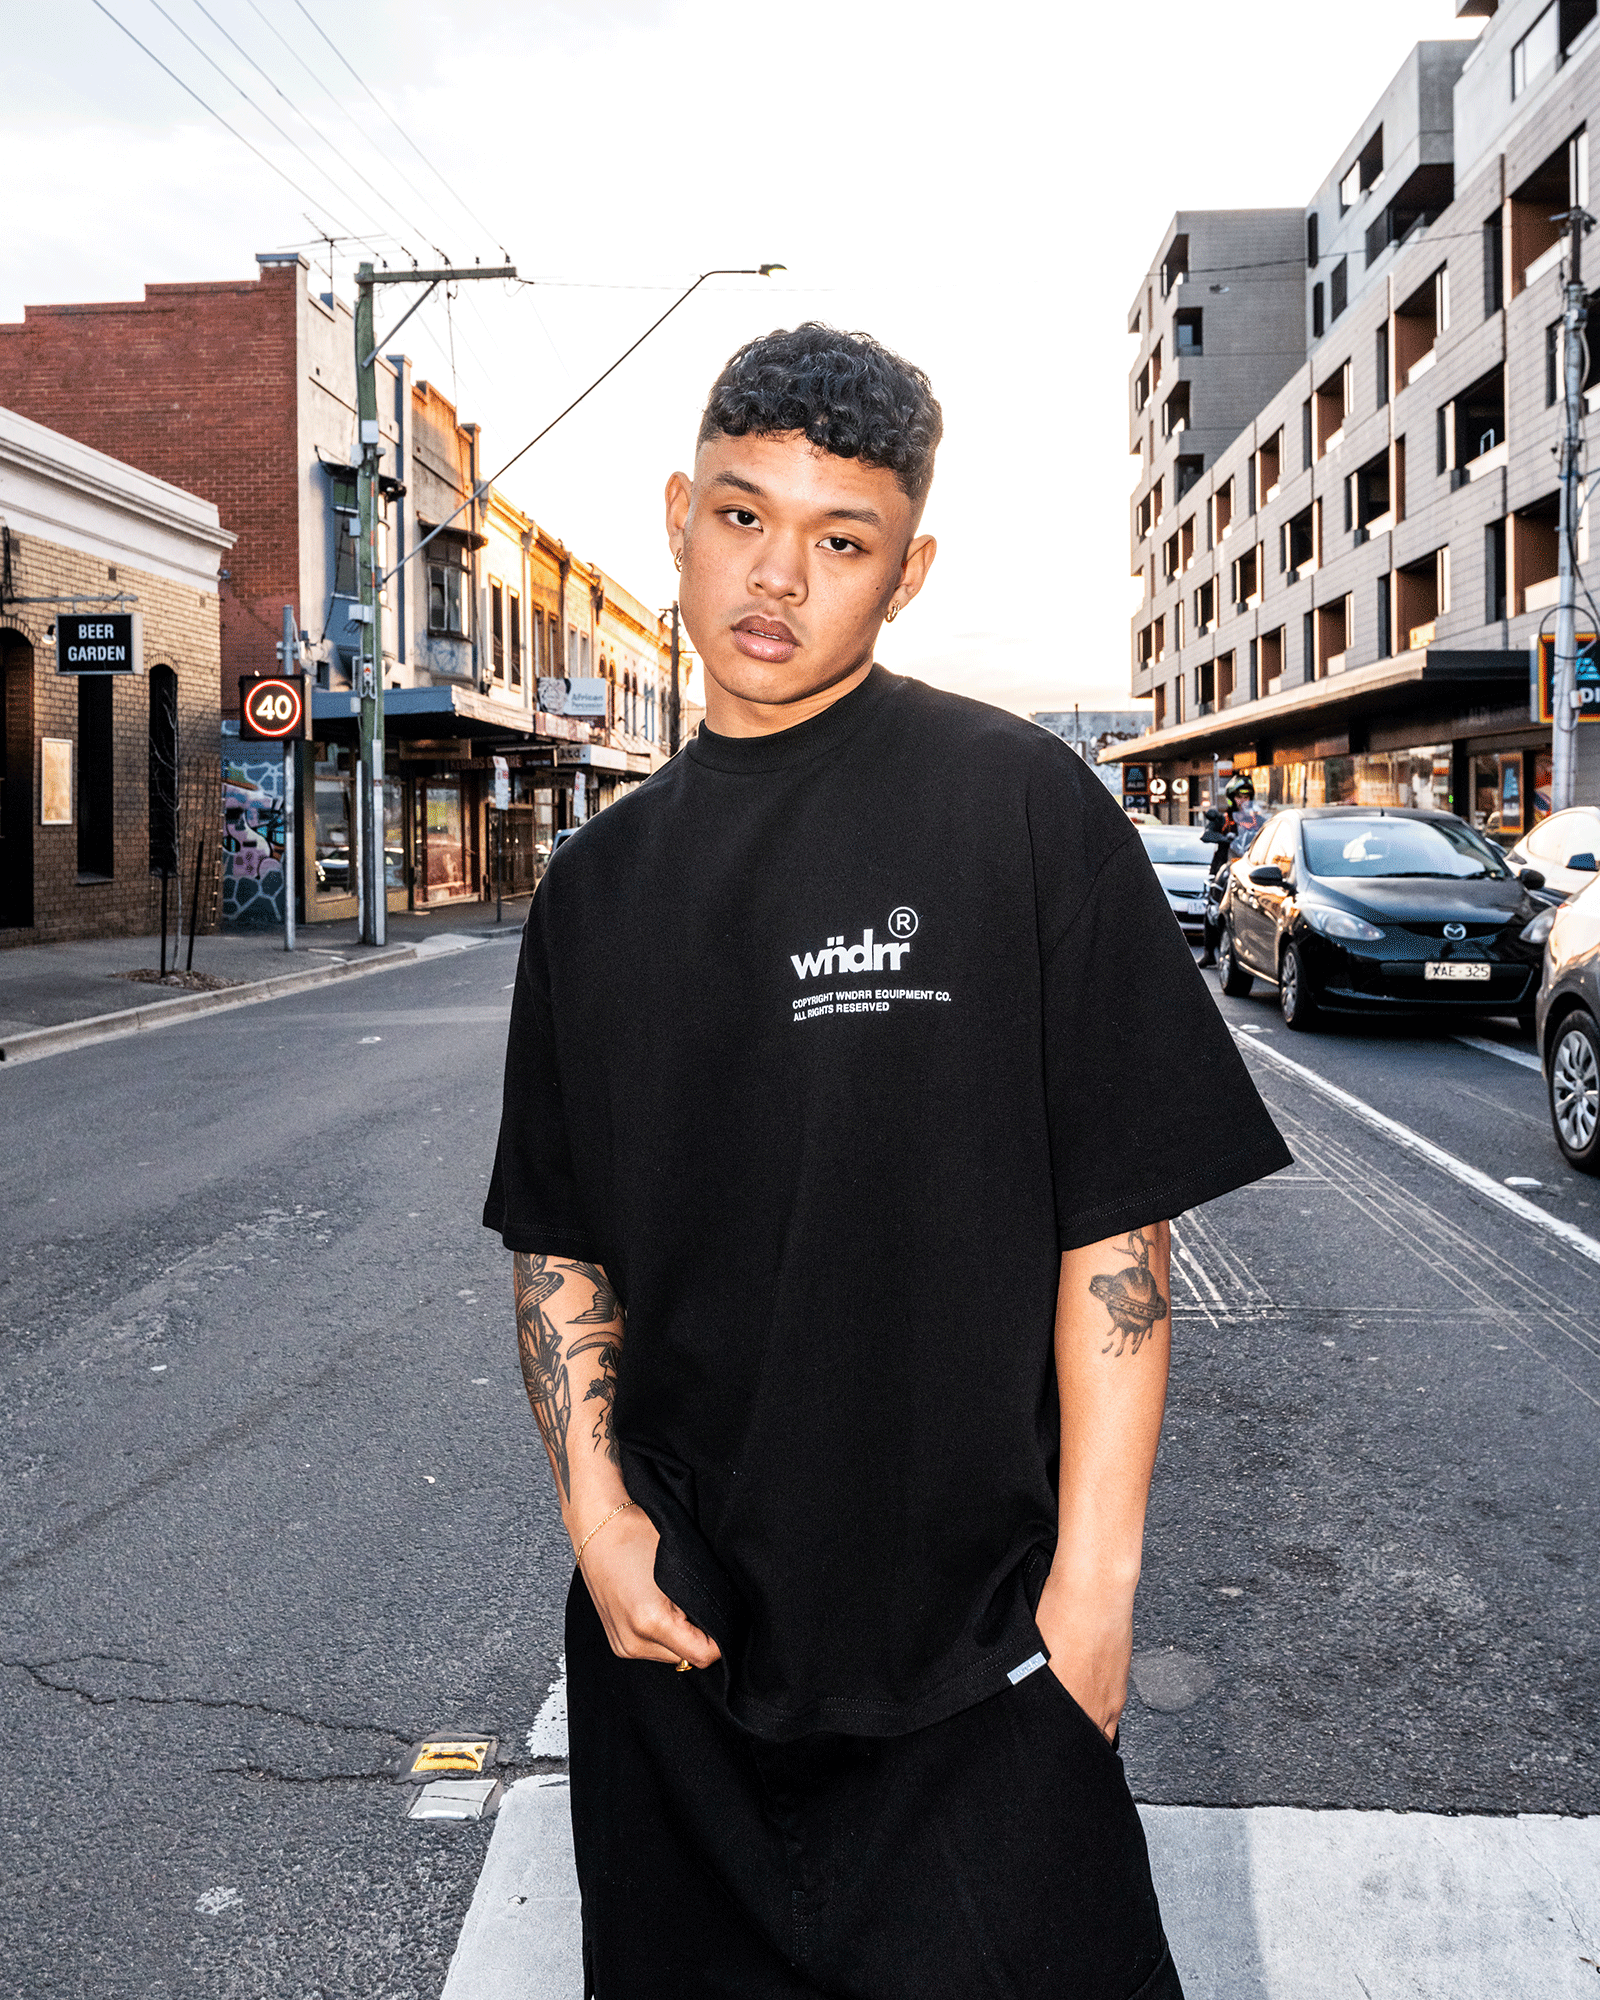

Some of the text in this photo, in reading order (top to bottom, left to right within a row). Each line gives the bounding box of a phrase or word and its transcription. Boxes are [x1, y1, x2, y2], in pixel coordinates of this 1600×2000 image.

[78, 624, 114, 639] BEER
[68, 646, 125, 661] GARDEN
[256, 694, 293, 720] 40
[792, 989, 952, 1010] COPYRIGHT WNDRR EQUIPMENT CO.
[793, 1002, 890, 1022] ALL RIGHTS RESERVED
